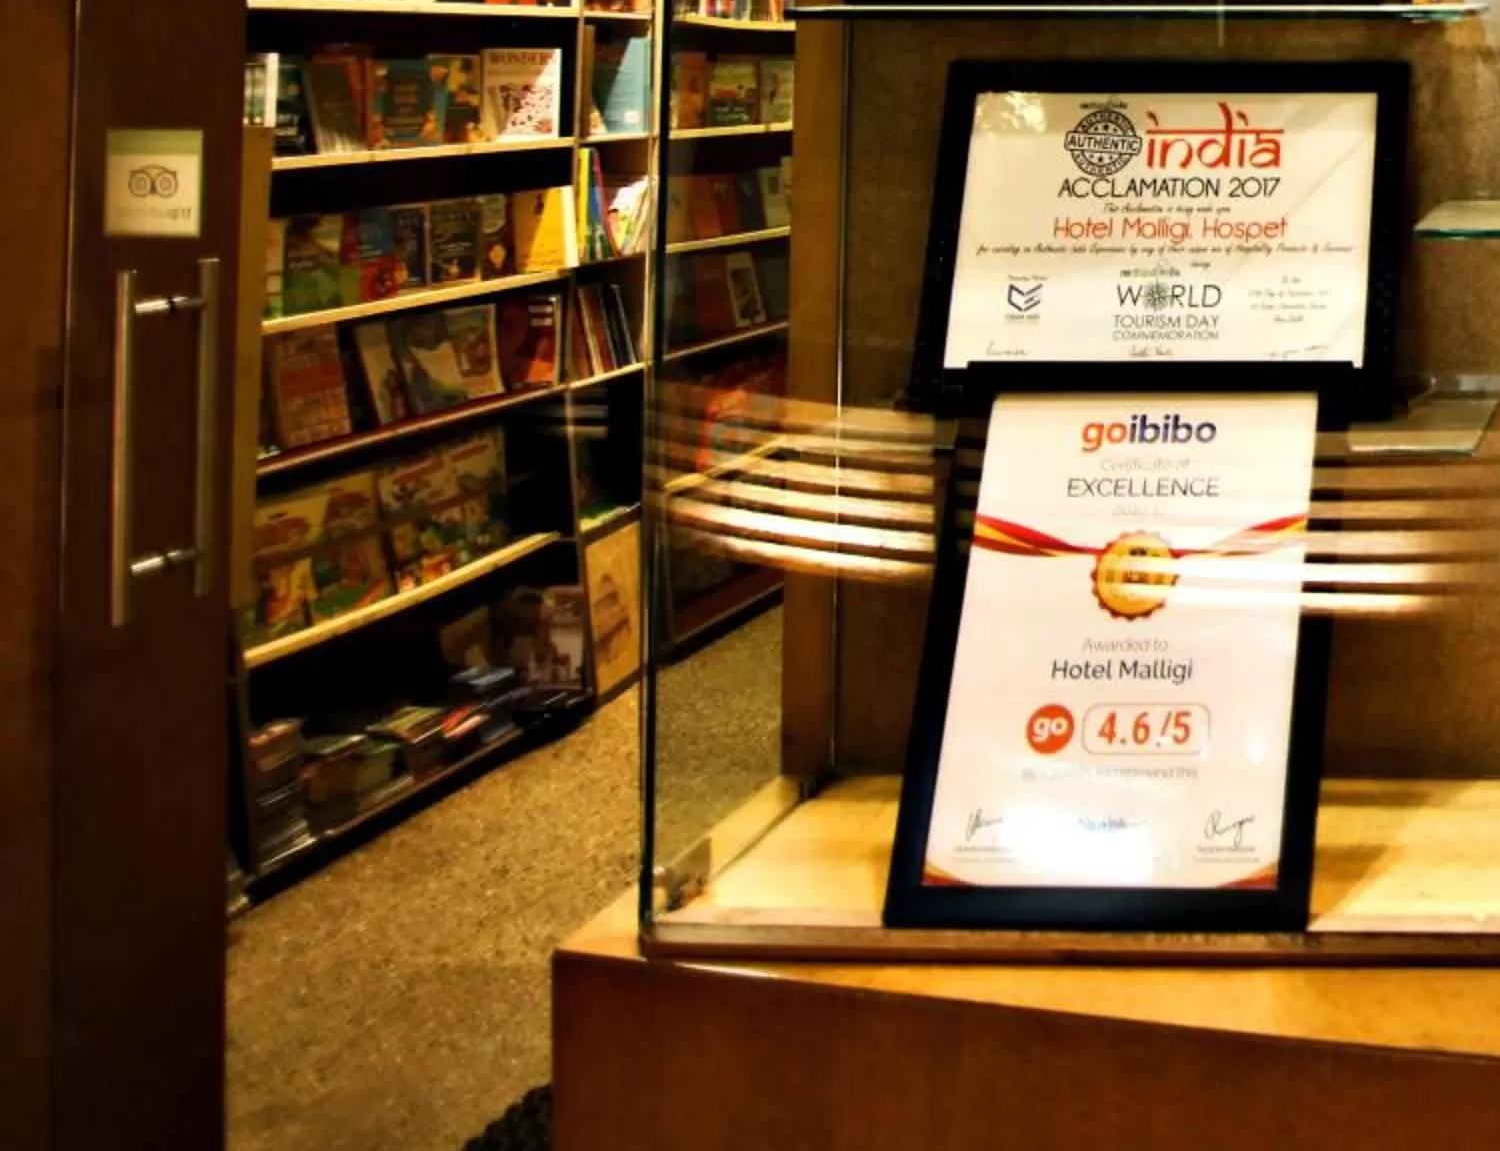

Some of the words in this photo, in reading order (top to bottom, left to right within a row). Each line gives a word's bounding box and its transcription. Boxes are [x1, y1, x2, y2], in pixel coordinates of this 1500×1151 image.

[1067, 134, 1140, 153] AUTHENTIC
[1145, 101, 1285, 170] india
[1057, 177, 1220, 199] ACCLAMATION
[1229, 177, 1282, 199] 2017
[1052, 216, 1114, 239] Hotel
[1203, 216, 1289, 244] Hospet
[1112, 315, 1181, 329] TOURISM
[1186, 314, 1220, 329] DAY
[1081, 414, 1217, 453] goibibo
[1067, 477, 1221, 498] EXCELLENCE
[1081, 637, 1150, 653] Awarded
[1153, 638, 1169, 653] to
[1050, 660, 1112, 681] Hotel
[1118, 659, 1194, 686] Malligi
[1032, 717, 1068, 743] go
